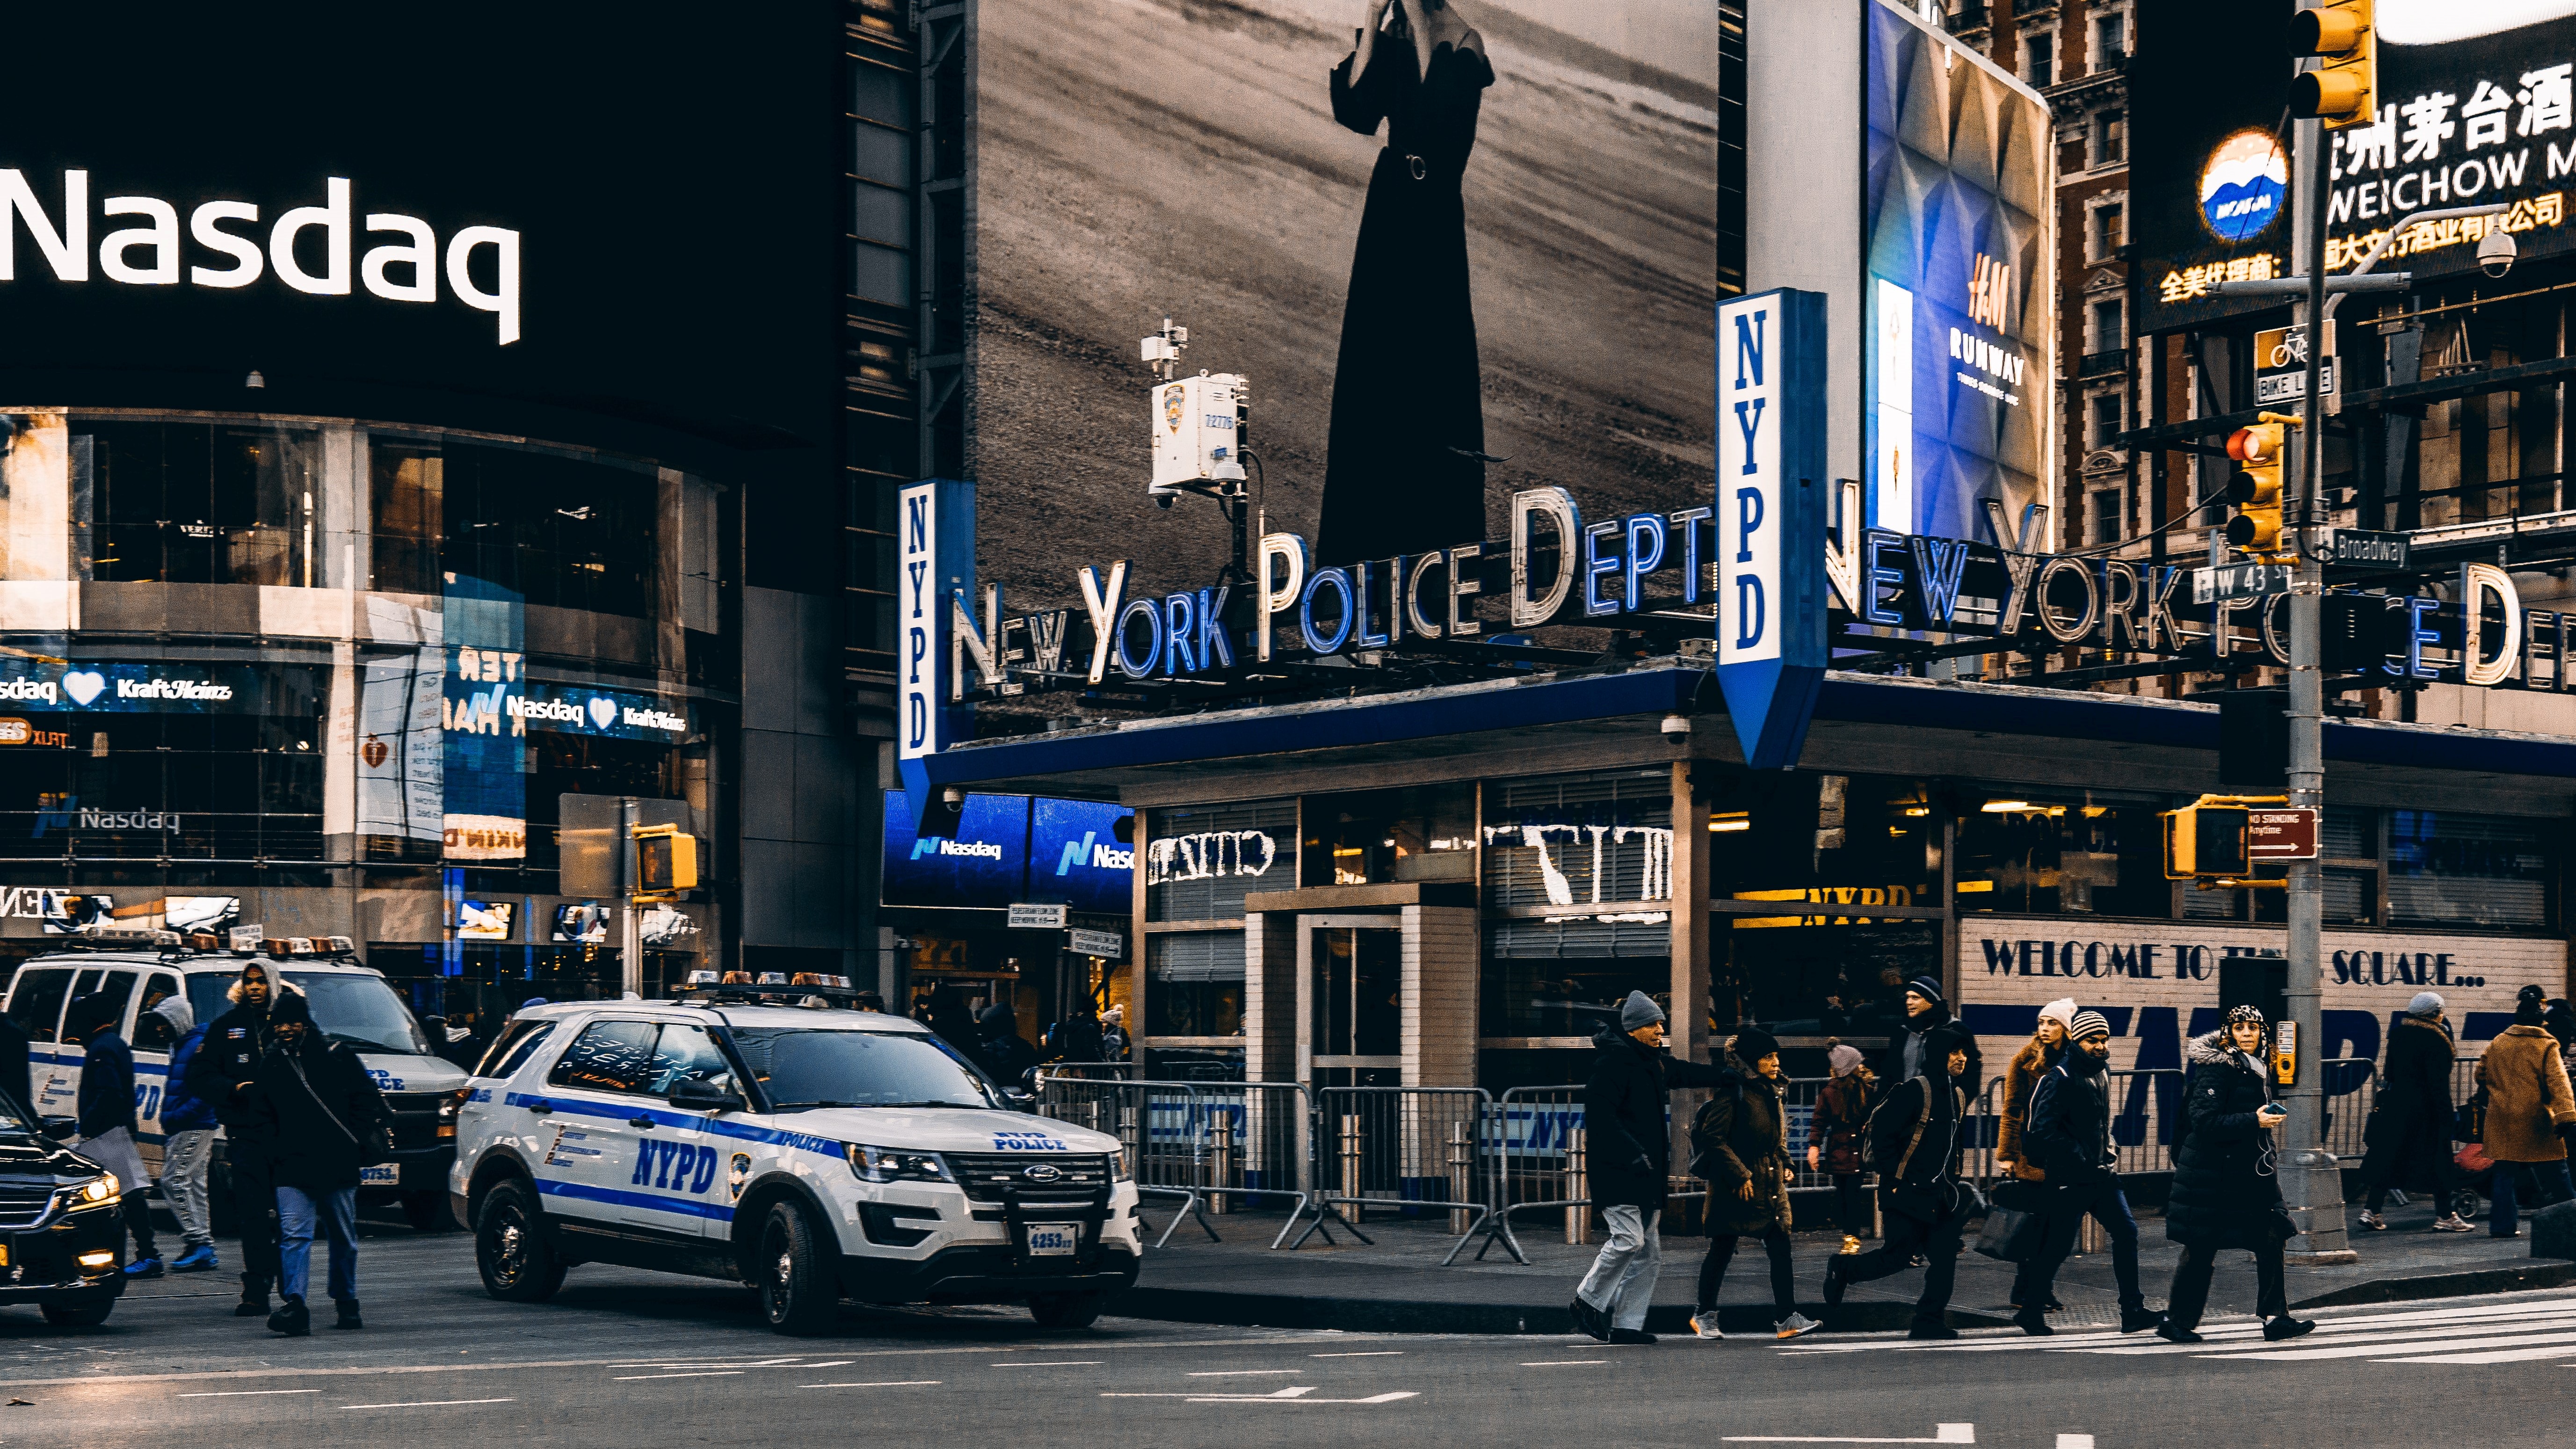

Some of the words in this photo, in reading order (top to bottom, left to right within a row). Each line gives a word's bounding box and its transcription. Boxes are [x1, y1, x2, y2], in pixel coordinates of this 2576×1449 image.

[2330, 63, 2572, 181] 州茅台酒
[0, 169, 520, 345] Nasdaq
[1950, 327, 2025, 386] RUNWAY
[2259, 377, 2289, 397] BIKE
[2294, 369, 2330, 392] LE
[1734, 310, 1767, 650] NYPD
[2338, 535, 2406, 568] Broadway
[1987, 501, 2181, 650] YORK
[2217, 569, 2235, 595] W
[2244, 566, 2265, 591] 43
[951, 582, 1067, 703] NEW
[1079, 563, 1233, 685] YORK
[1258, 532, 1481, 662] POLICE
[1511, 487, 1712, 627] DEPT
[909, 494, 928, 750] NYPD
[507, 696, 583, 727] Nasdaq
[80, 807, 180, 834] Nasdaq
[2262, 814, 2300, 823] STANDING
[941, 840, 1001, 860] Nasdaq
[1804, 884, 1912, 927] NYPD
[1981, 939, 2163, 979] WELCOME
[2170, 944, 2213, 981] TO
[781, 1131, 826, 1153] POLICE
[993, 1139, 1067, 1150] POLICE
[632, 1137, 718, 1194] NYPD
[1031, 1233, 1062, 1248] 4253
